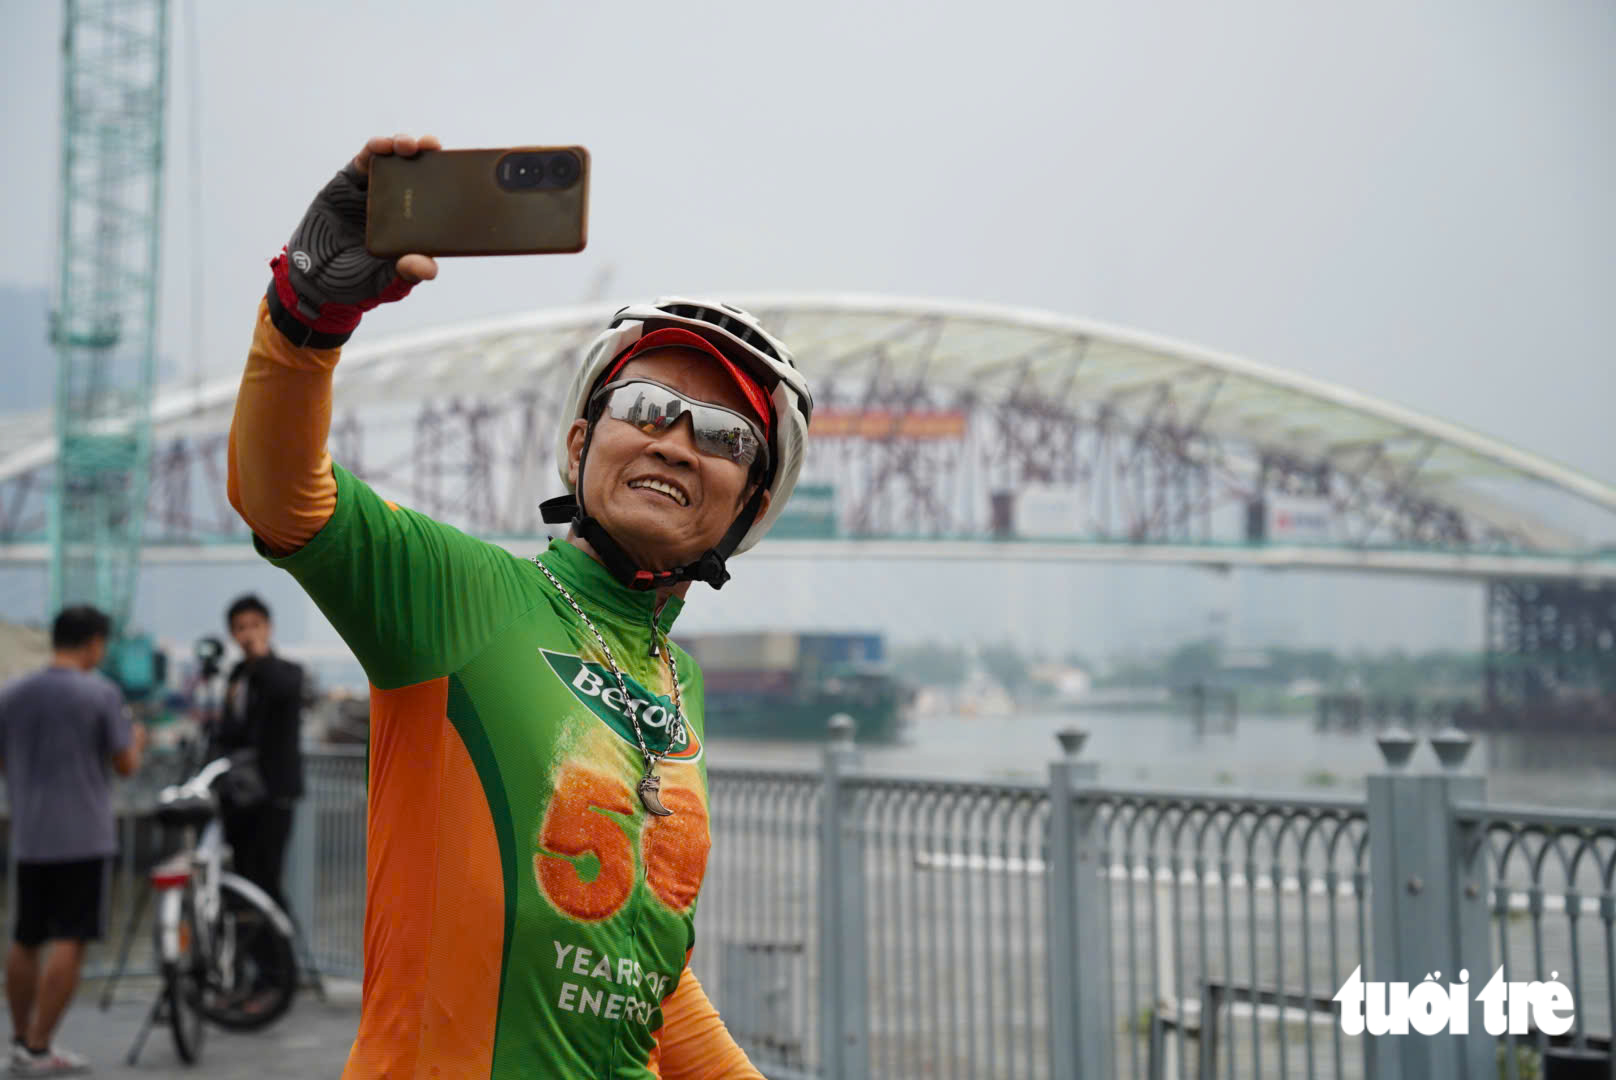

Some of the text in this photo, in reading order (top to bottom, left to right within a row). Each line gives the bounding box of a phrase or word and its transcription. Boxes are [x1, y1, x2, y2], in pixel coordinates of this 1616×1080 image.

[534, 762, 711, 921] 50
[553, 940, 671, 999] YEARS OF
